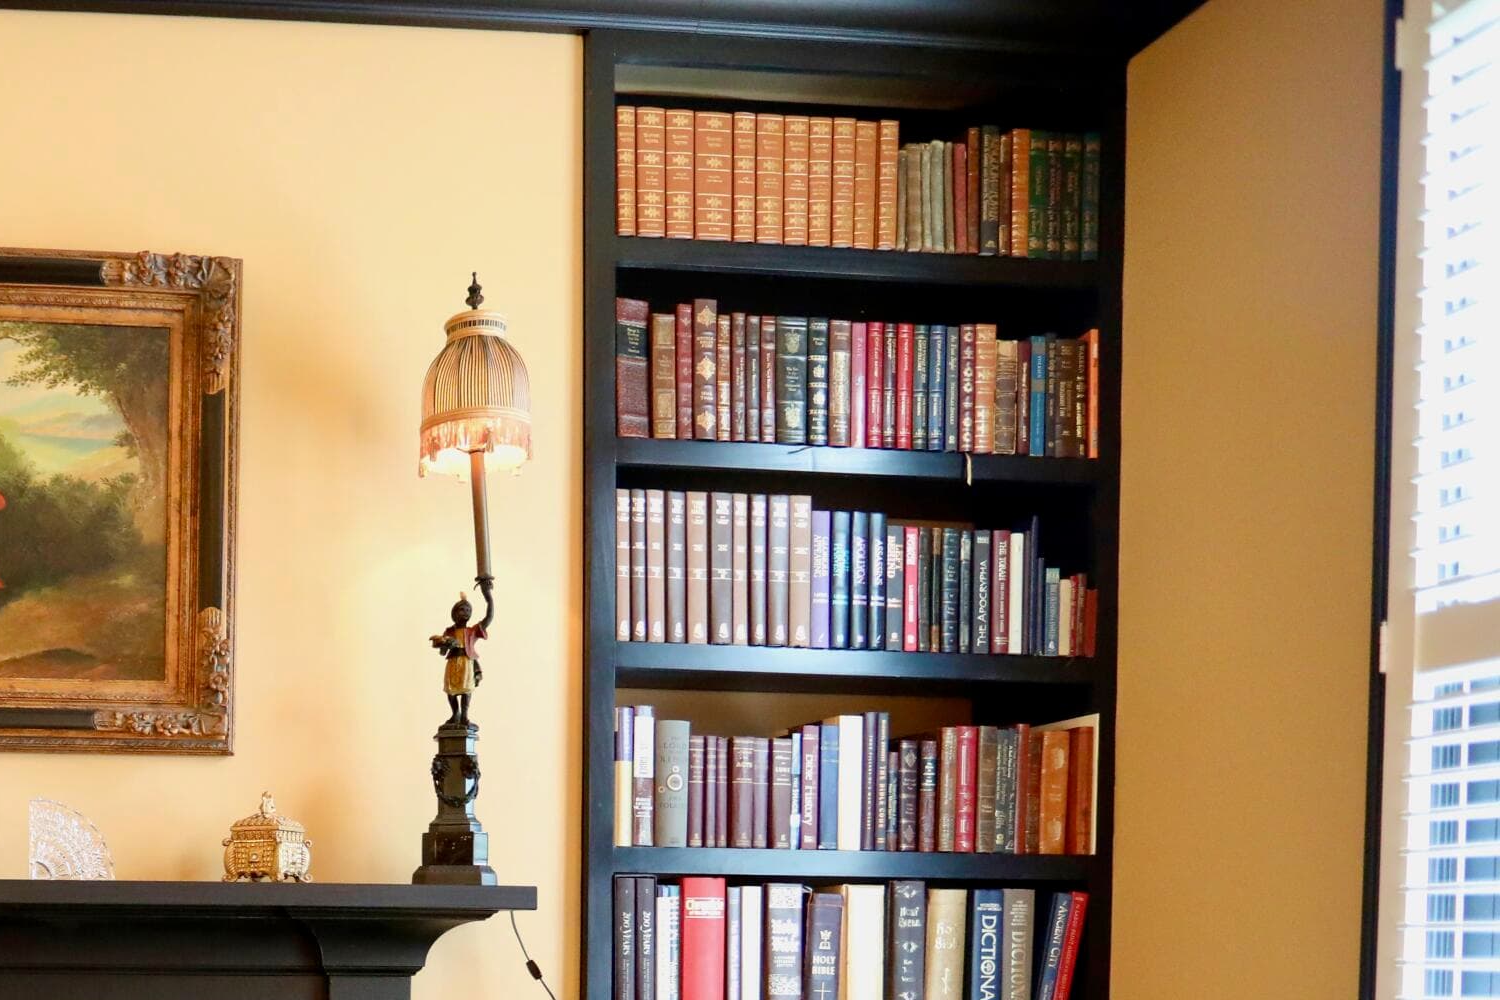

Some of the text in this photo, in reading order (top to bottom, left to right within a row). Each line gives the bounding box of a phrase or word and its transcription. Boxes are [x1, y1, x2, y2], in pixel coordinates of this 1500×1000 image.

[855, 536, 866, 585] APOLLYON
[875, 538, 884, 586] ASSASSINS
[887, 535, 896, 579] BEHIND
[895, 544, 903, 572] LEFT
[998, 540, 1007, 581] THE TORAH
[977, 559, 988, 647] THE APOCRYPHA
[802, 753, 814, 827] Bible History
[619, 911, 631, 956] 200 YEARS
[639, 911, 652, 955] 200 YEARS
[1048, 904, 1068, 970] ANCIENT CITY
[811, 965, 836, 976] BIBLE
[812, 955, 837, 965] HOLY
